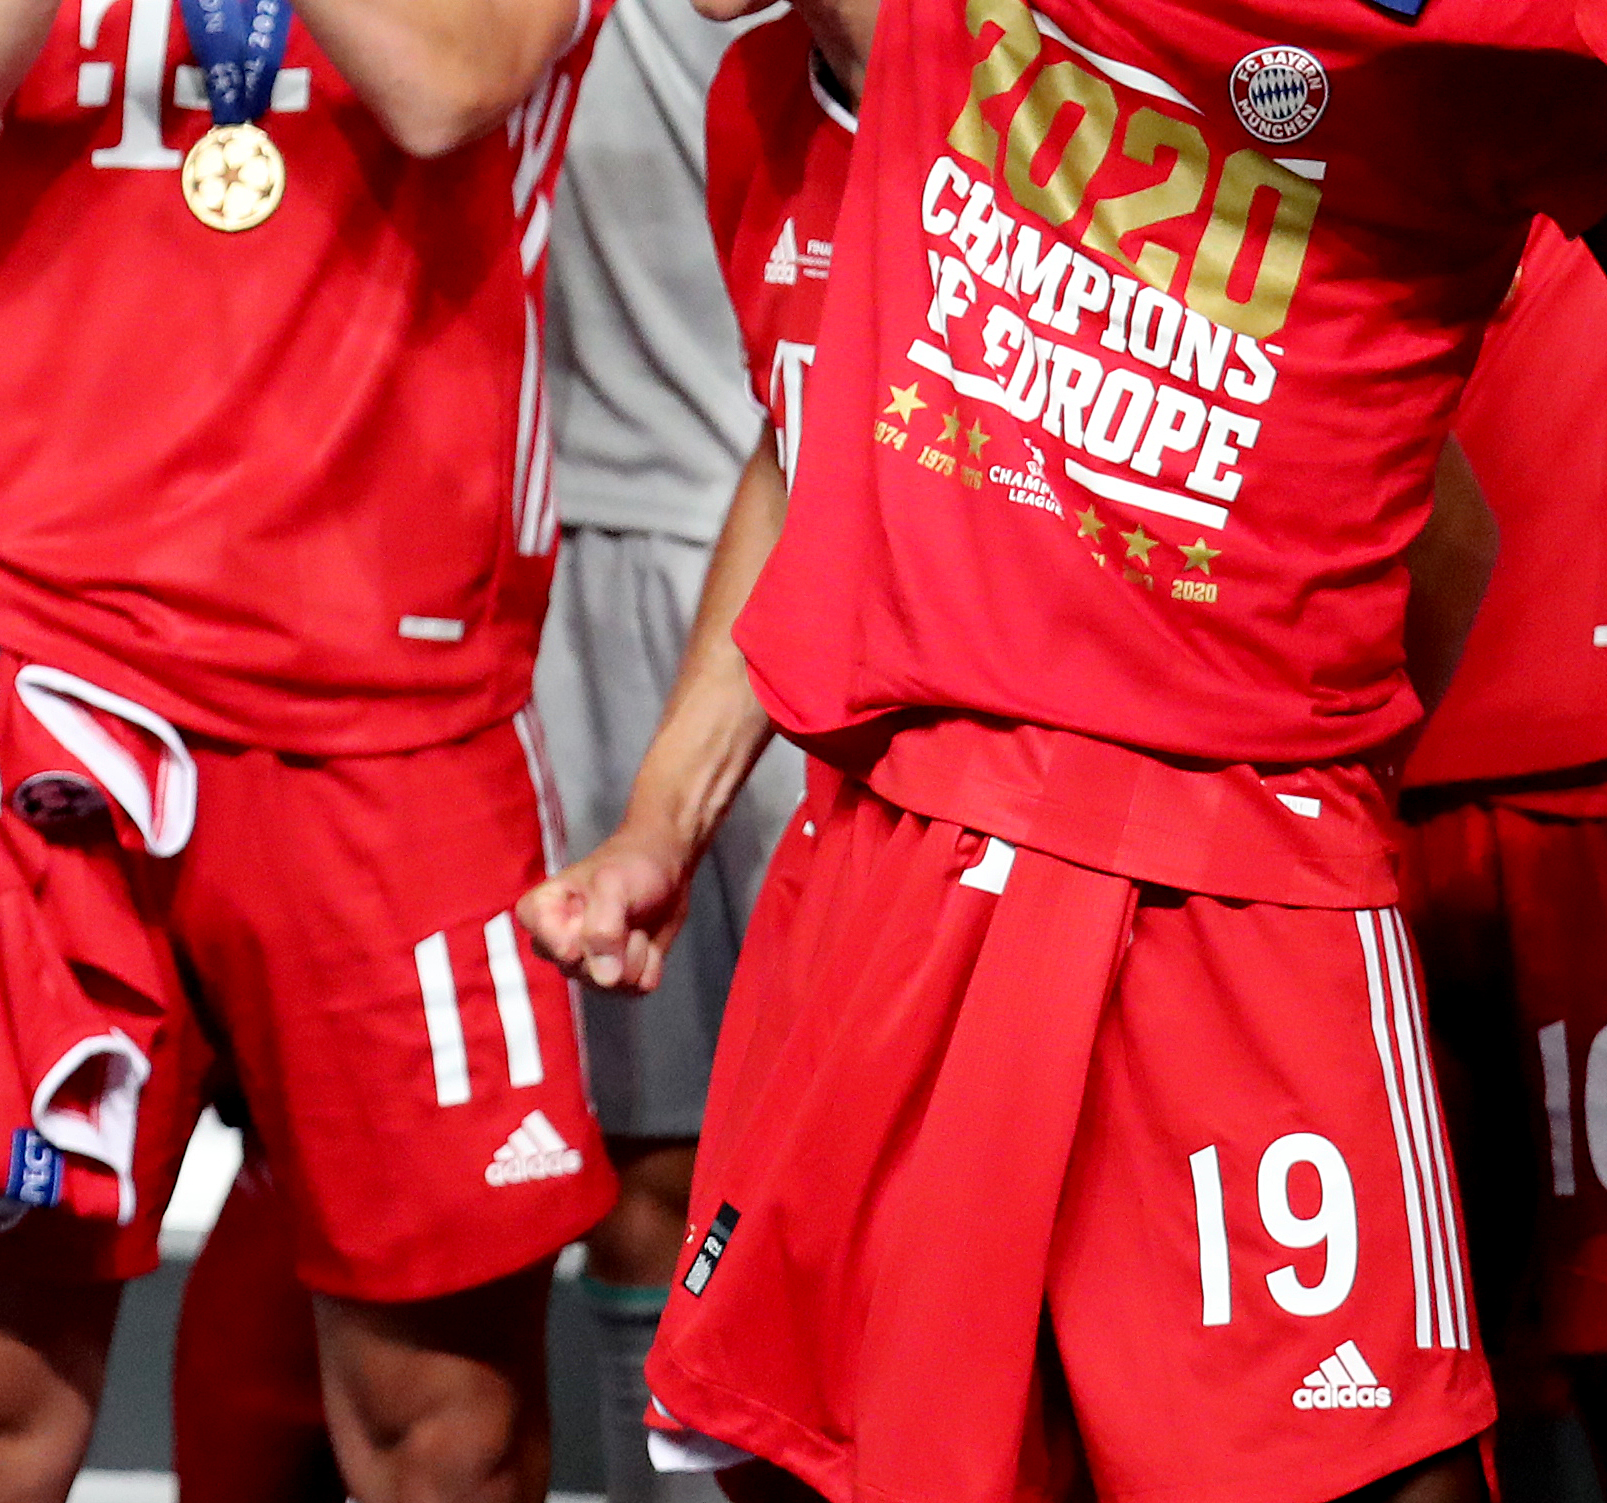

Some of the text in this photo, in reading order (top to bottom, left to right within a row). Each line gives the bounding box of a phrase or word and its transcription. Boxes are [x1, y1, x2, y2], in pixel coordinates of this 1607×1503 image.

[1237, 51, 1323, 91] FC BAYERN
[981, 304, 1262, 503] EUROPE
[1171, 578, 1219, 604] 2020
[413, 909, 545, 1108] 11
[484, 1148, 583, 1188] adidas
[1188, 1131, 1360, 1326] 19
[1291, 1382, 1393, 1410] adidas
